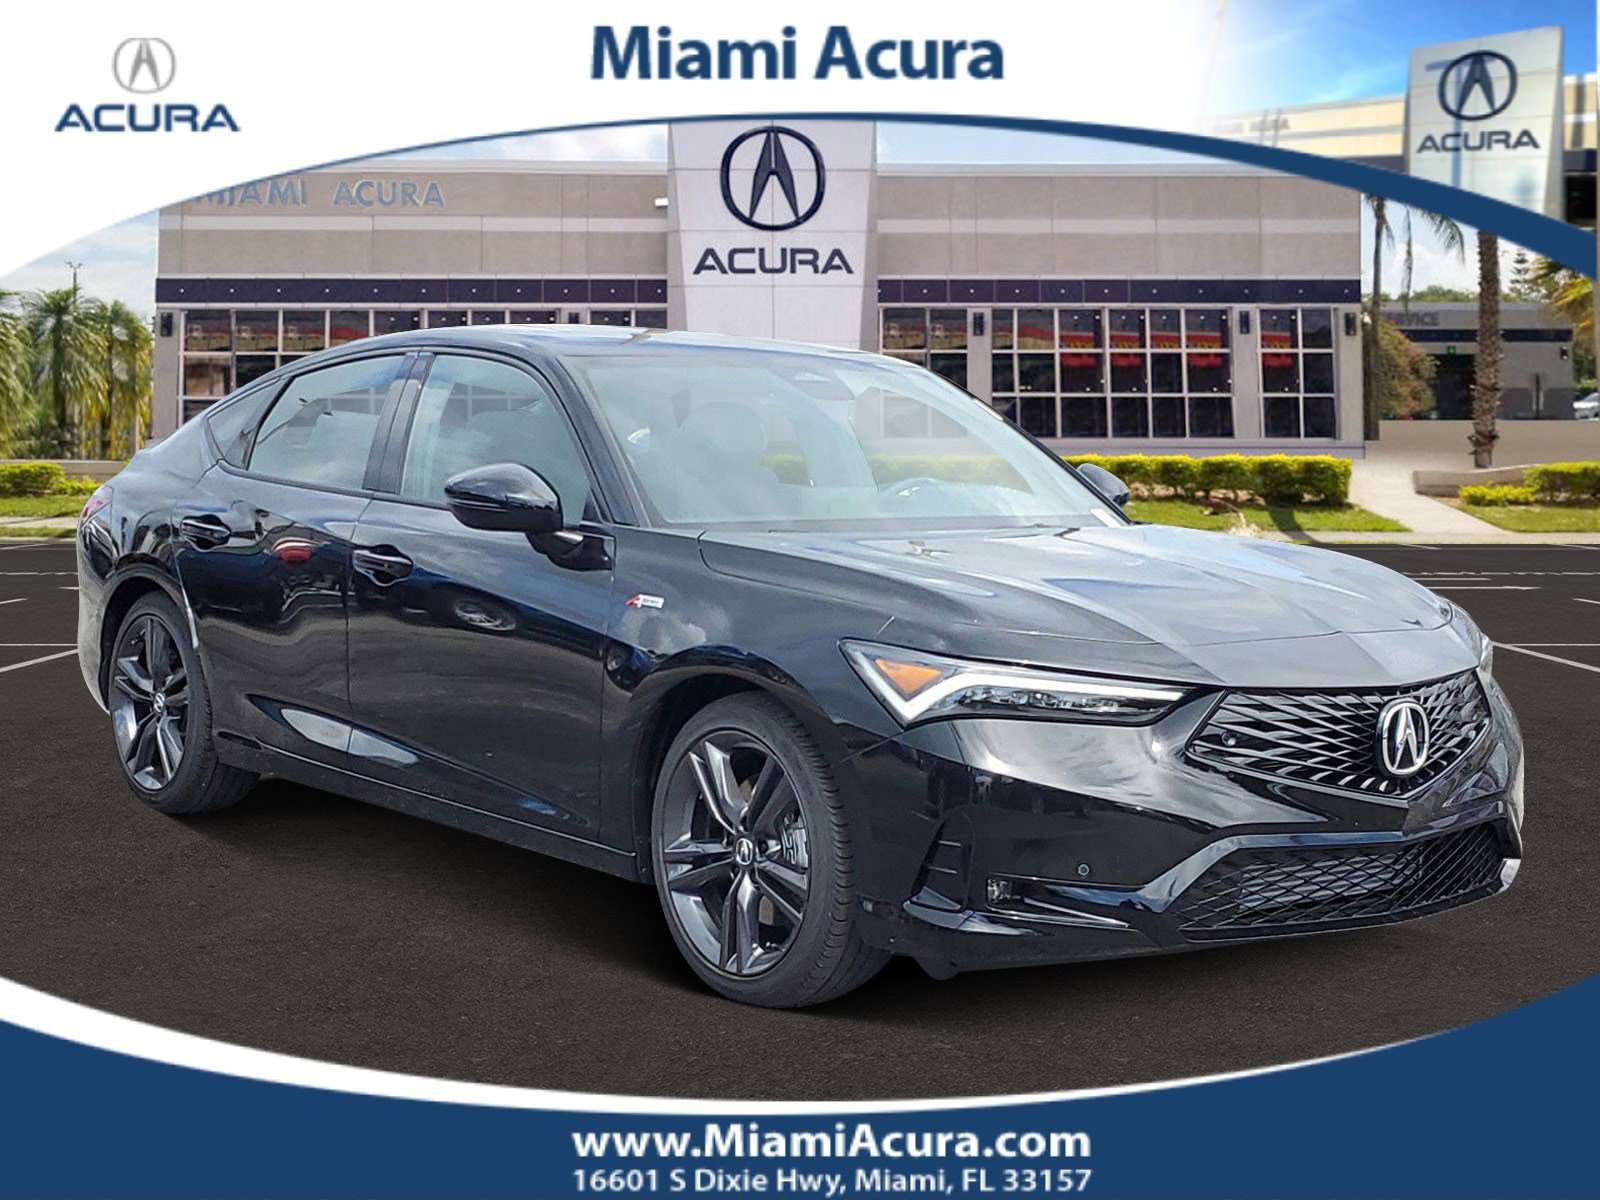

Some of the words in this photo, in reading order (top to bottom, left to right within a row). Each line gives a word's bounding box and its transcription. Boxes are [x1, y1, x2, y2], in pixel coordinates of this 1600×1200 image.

[1417, 129, 1540, 154] ACURA
[332, 180, 446, 207] ACURA
[693, 247, 854, 275] ACURA
